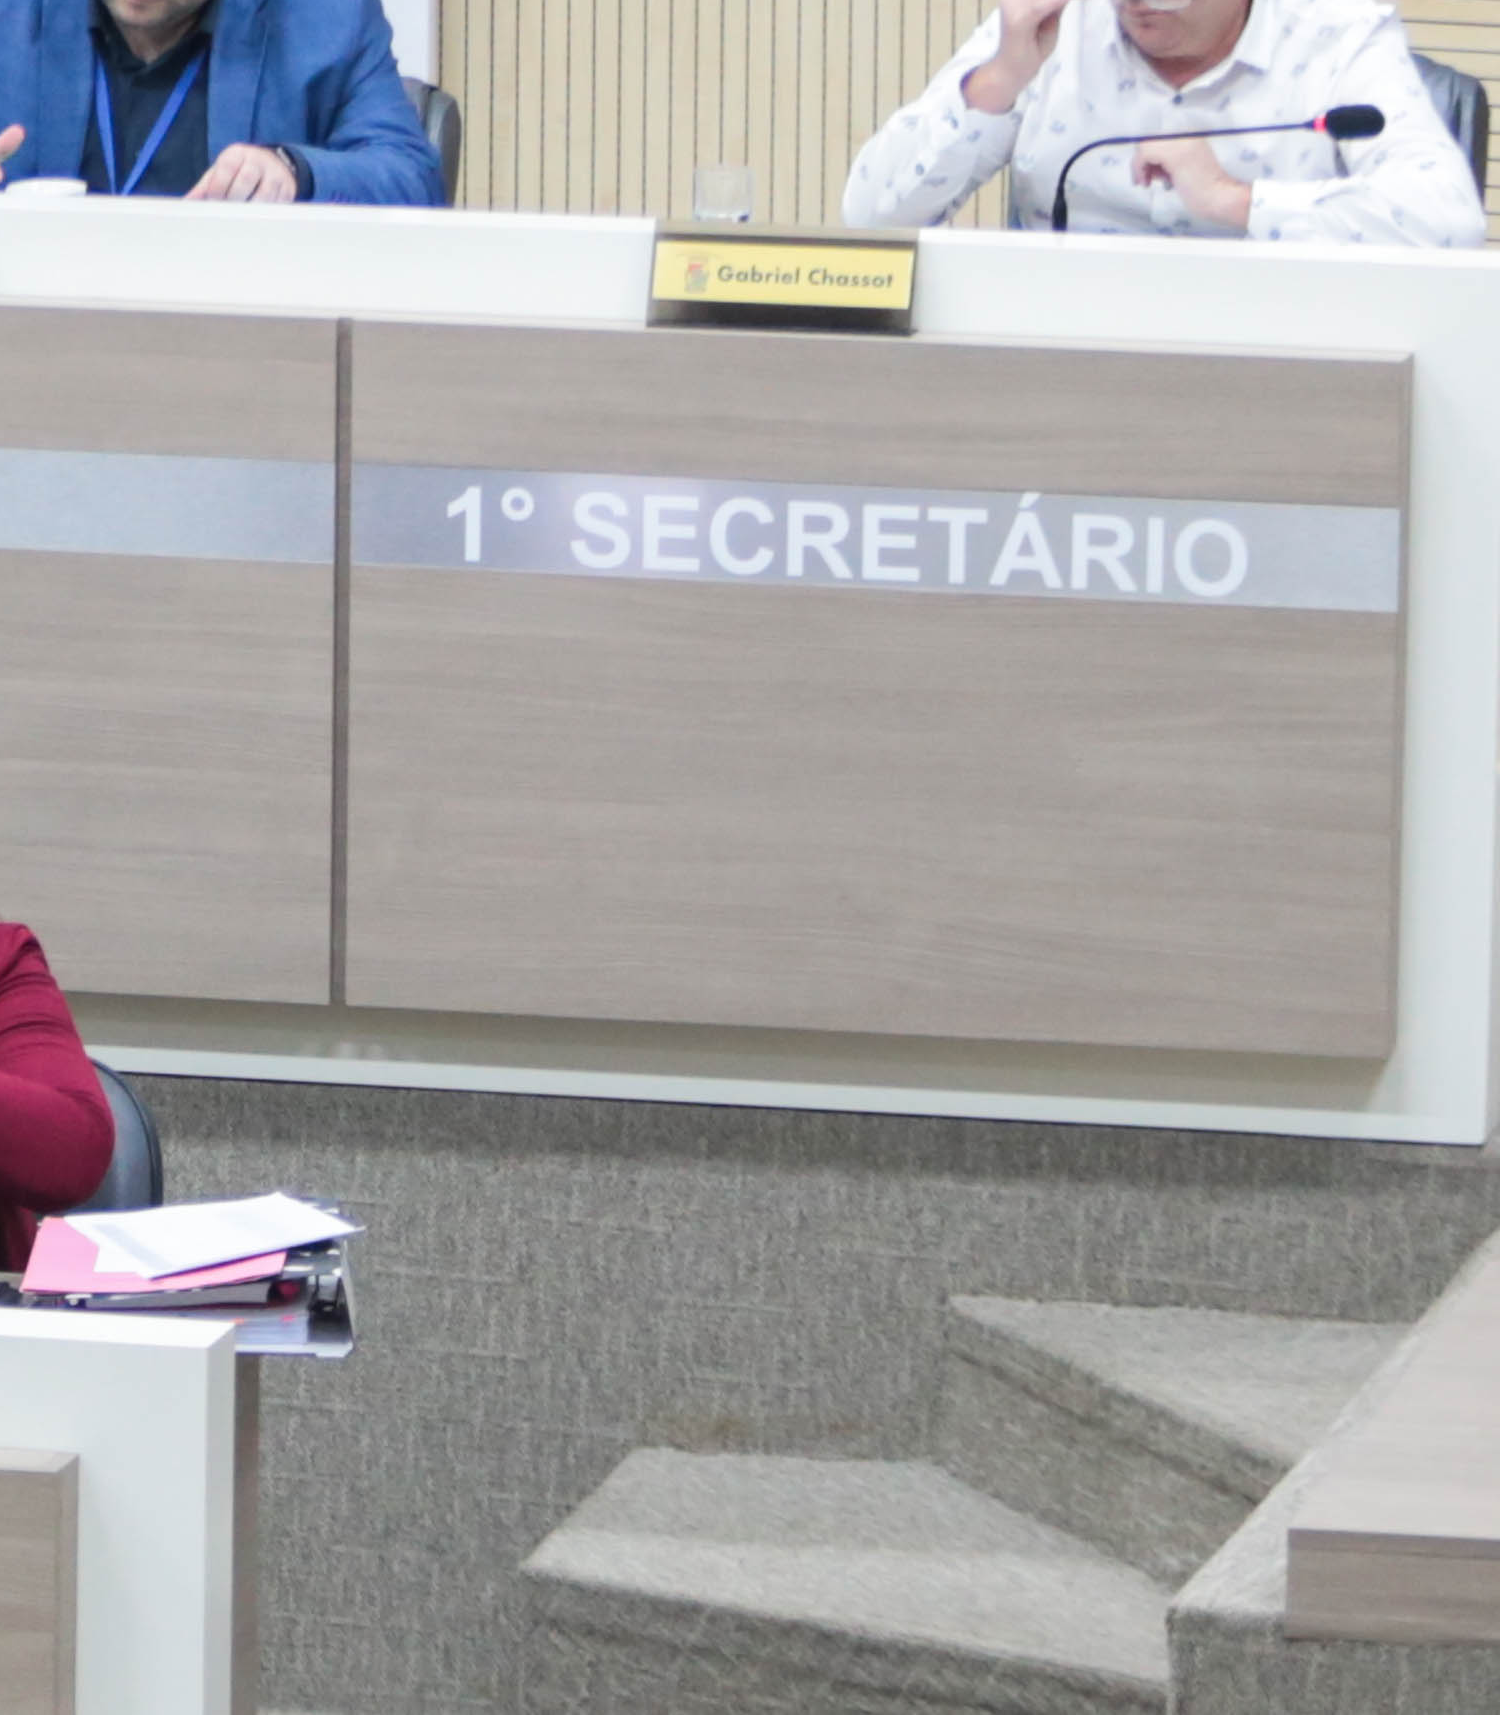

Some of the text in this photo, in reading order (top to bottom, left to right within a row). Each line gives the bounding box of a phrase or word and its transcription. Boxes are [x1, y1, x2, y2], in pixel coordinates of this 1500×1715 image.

[717, 265, 893, 289] Gabriel Chassot
[569, 491, 1250, 599] SECRETÁRIO
